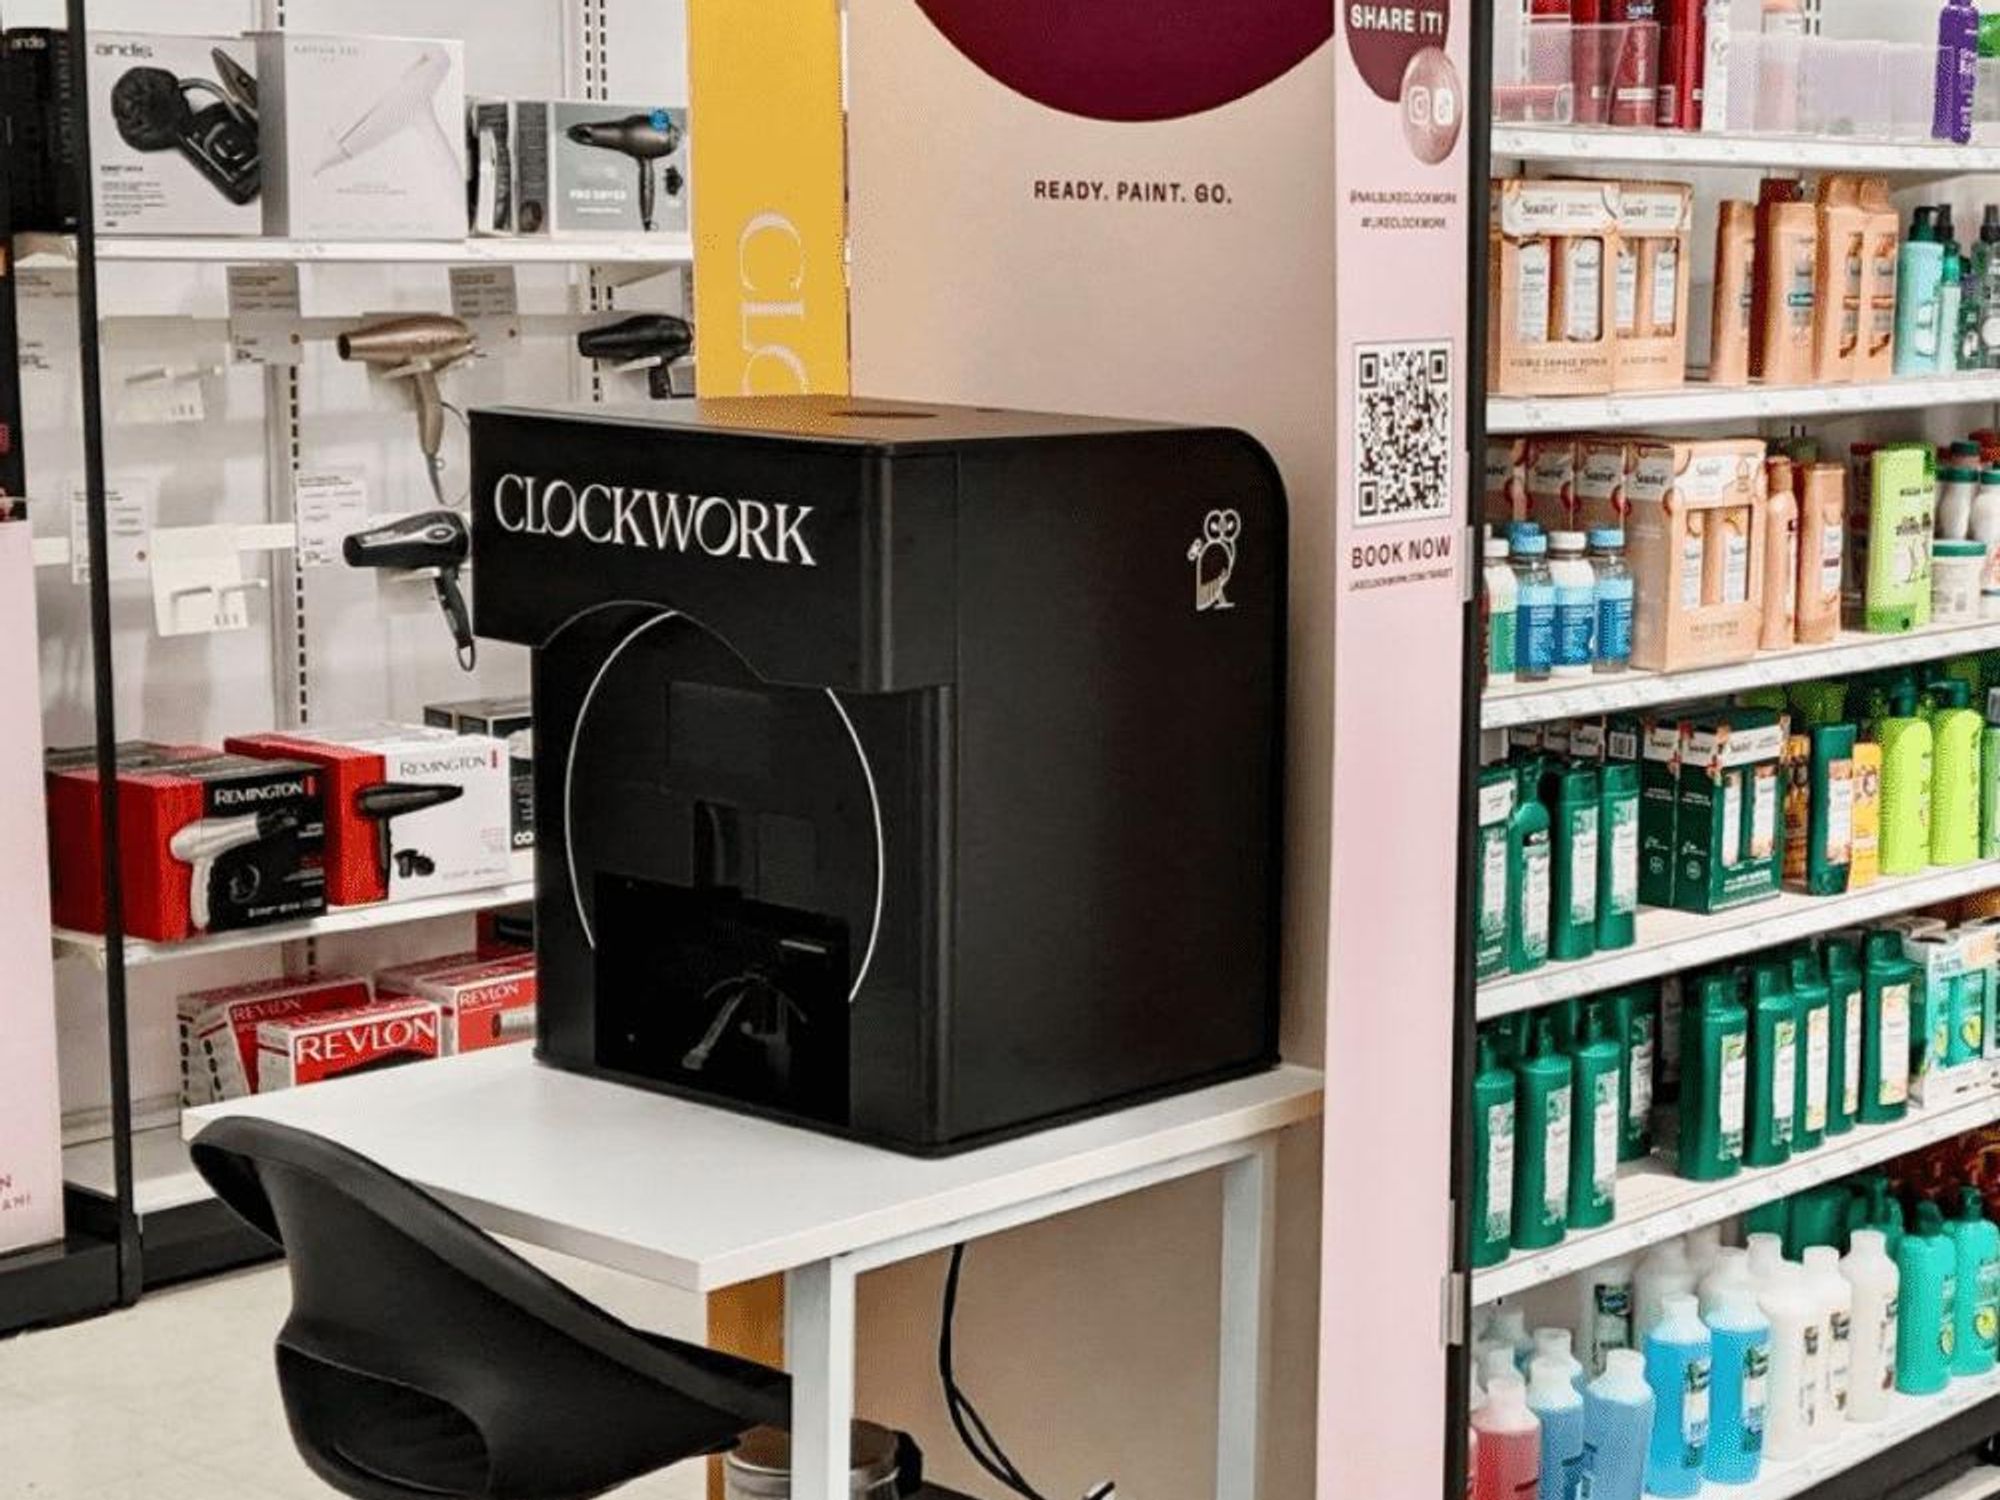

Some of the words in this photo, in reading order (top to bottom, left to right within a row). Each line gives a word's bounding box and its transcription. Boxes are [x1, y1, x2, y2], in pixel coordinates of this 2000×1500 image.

[1350, 4, 1414, 32] SHARE
[1420, 11, 1443, 35] IT!
[1034, 179, 1108, 201] READY.
[1117, 181, 1186, 203] PAINT.
[1194, 183, 1232, 204] GO.
[494, 473, 817, 566] CLOCKWORK
[1352, 542, 1404, 569] BOOK
[1409, 535, 1451, 560] NOW
[400, 756, 486, 776] REMINGTON
[214, 779, 304, 806] REMINGTON
[458, 982, 520, 1007] REVLON
[231, 999, 301, 1022] REVLON
[297, 1015, 438, 1064] REVLON
